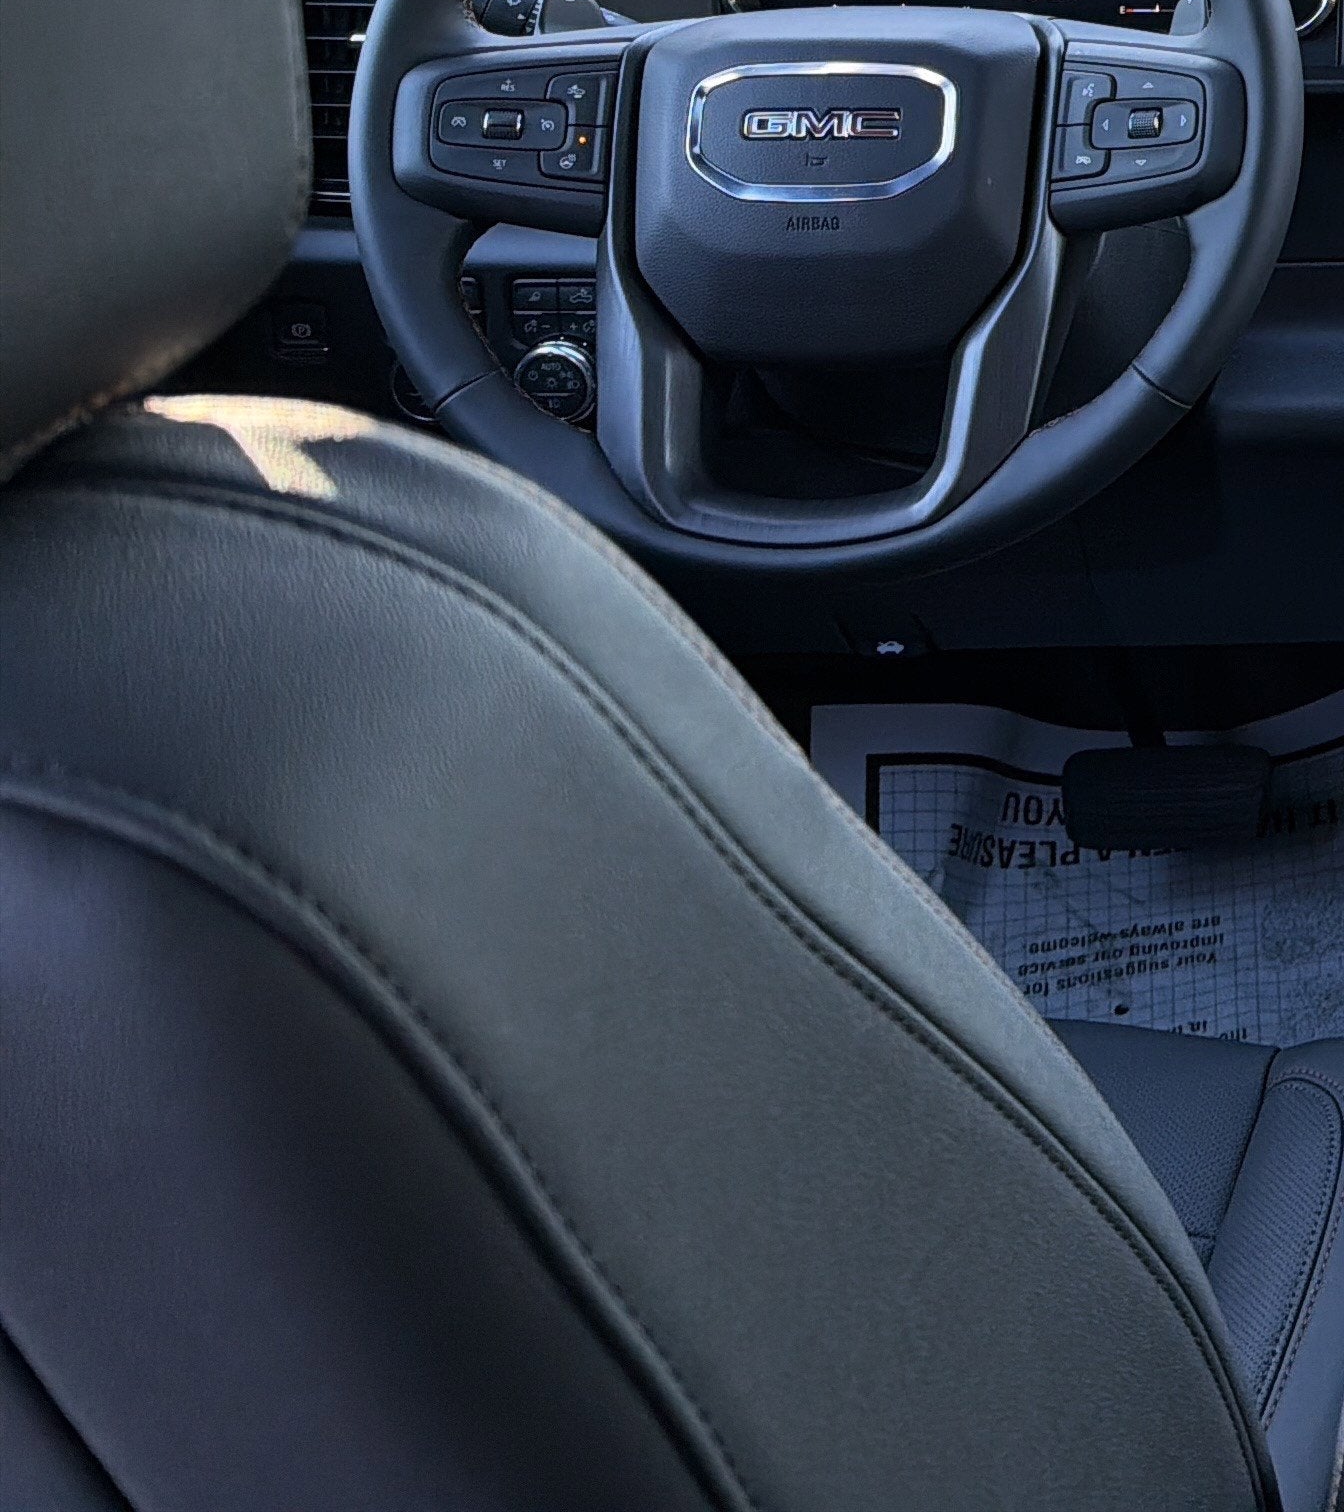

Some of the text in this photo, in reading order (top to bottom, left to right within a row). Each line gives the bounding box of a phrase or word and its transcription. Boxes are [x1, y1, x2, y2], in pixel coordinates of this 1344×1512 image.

[743, 108, 901, 140] GMC
[786, 216, 840, 232] AIRBAG
[1000, 791, 1070, 827] YOU
[949, 823, 1080, 870] PLEASURE
[1119, 919, 1186, 938] always
[1190, 915, 1221, 930] are
[1176, 951, 1218, 968] Your
[1056, 959, 1170, 993] suggestions
